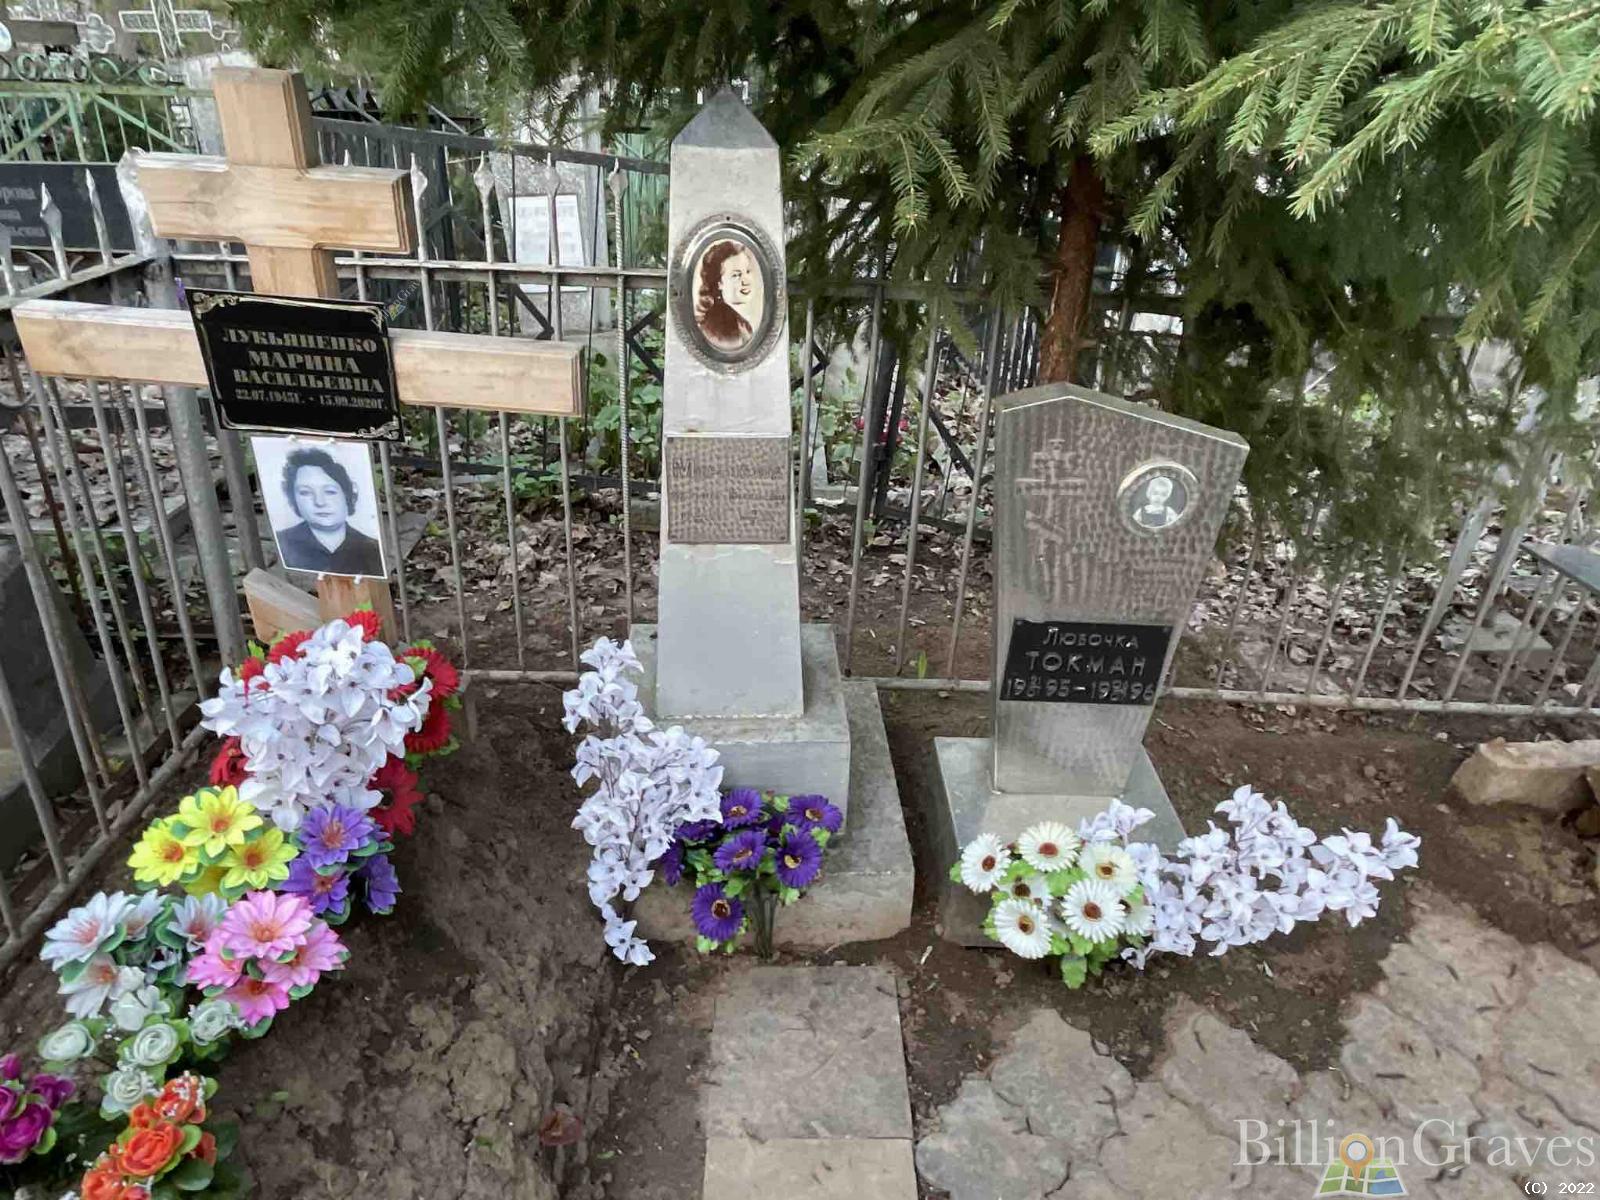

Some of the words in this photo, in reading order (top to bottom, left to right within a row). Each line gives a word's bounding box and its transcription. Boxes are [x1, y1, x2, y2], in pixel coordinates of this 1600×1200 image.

[222, 328, 377, 353] ЛУКЬЯНЕНКО
[248, 350, 361, 374] МАРИНА
[233, 368, 384, 393] ВАСИЛЬЕВНА
[1025, 650, 1146, 677] ТОКМАН
